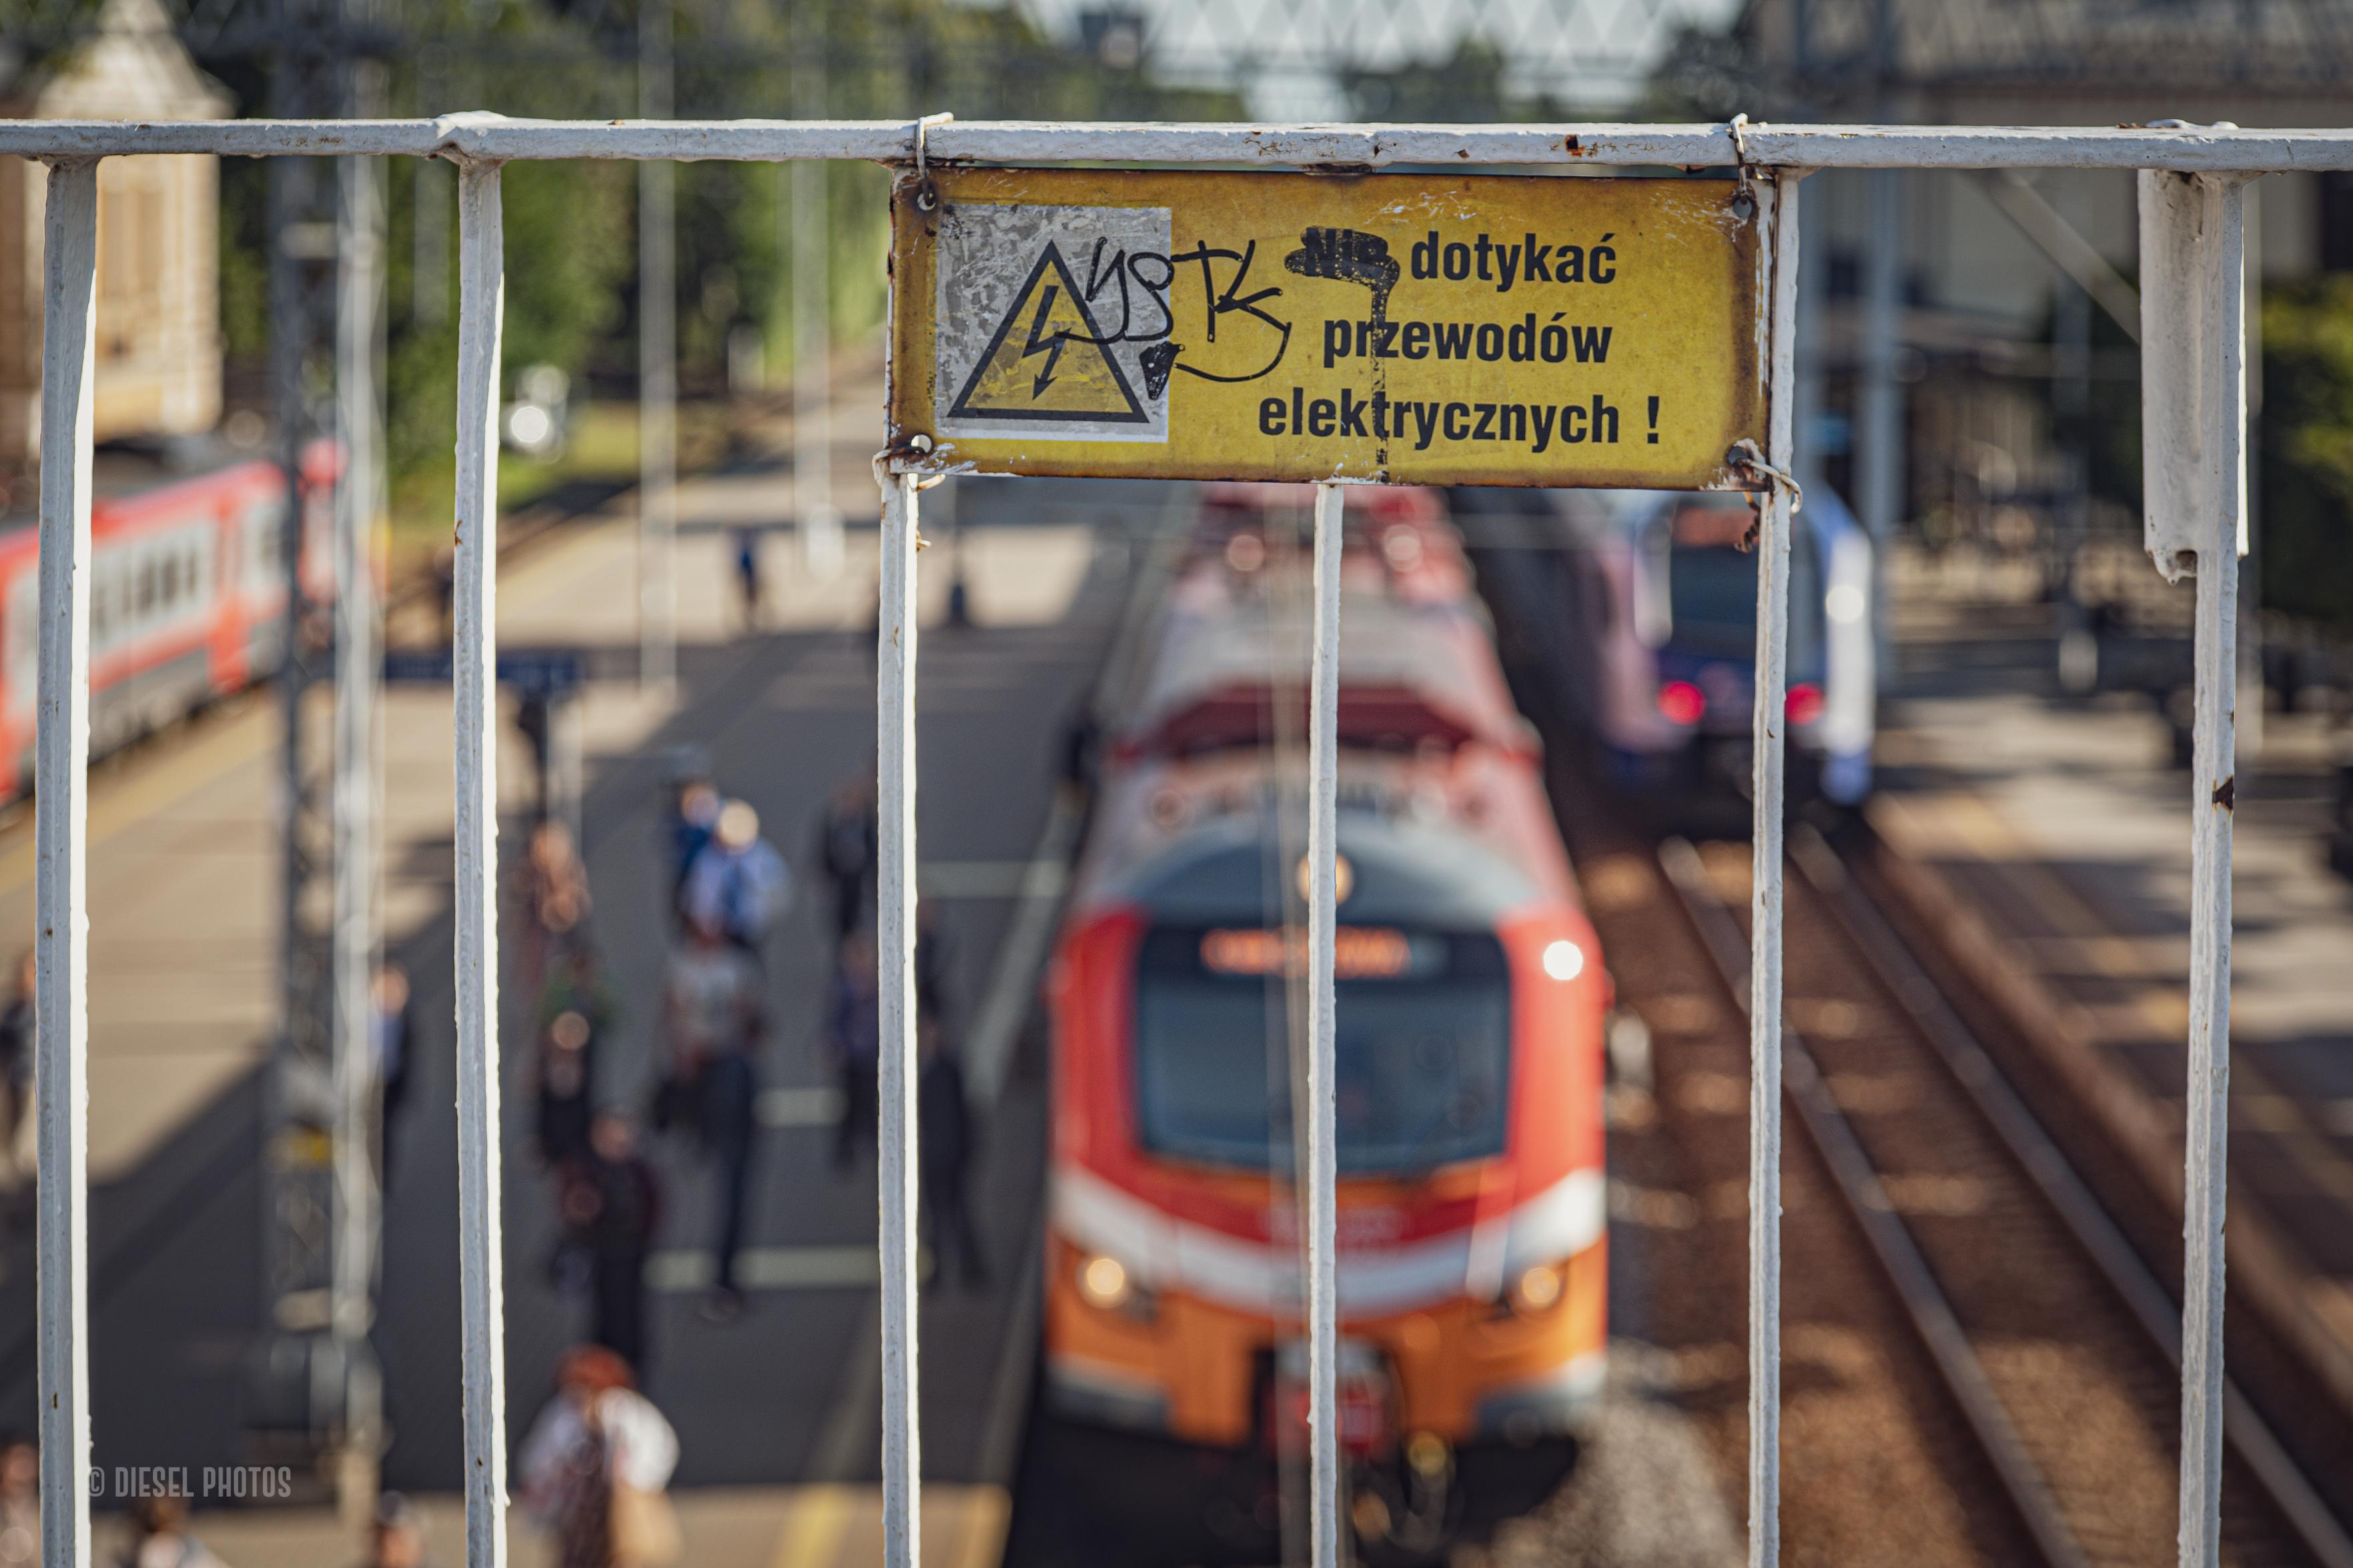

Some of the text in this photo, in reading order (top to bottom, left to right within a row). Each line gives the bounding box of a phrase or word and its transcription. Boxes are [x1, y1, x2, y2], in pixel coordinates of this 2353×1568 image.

[1411, 230, 1616, 292] dotykać
[1324, 312, 1612, 368] przewodów
[1259, 387, 1660, 453] elektrycznych !
